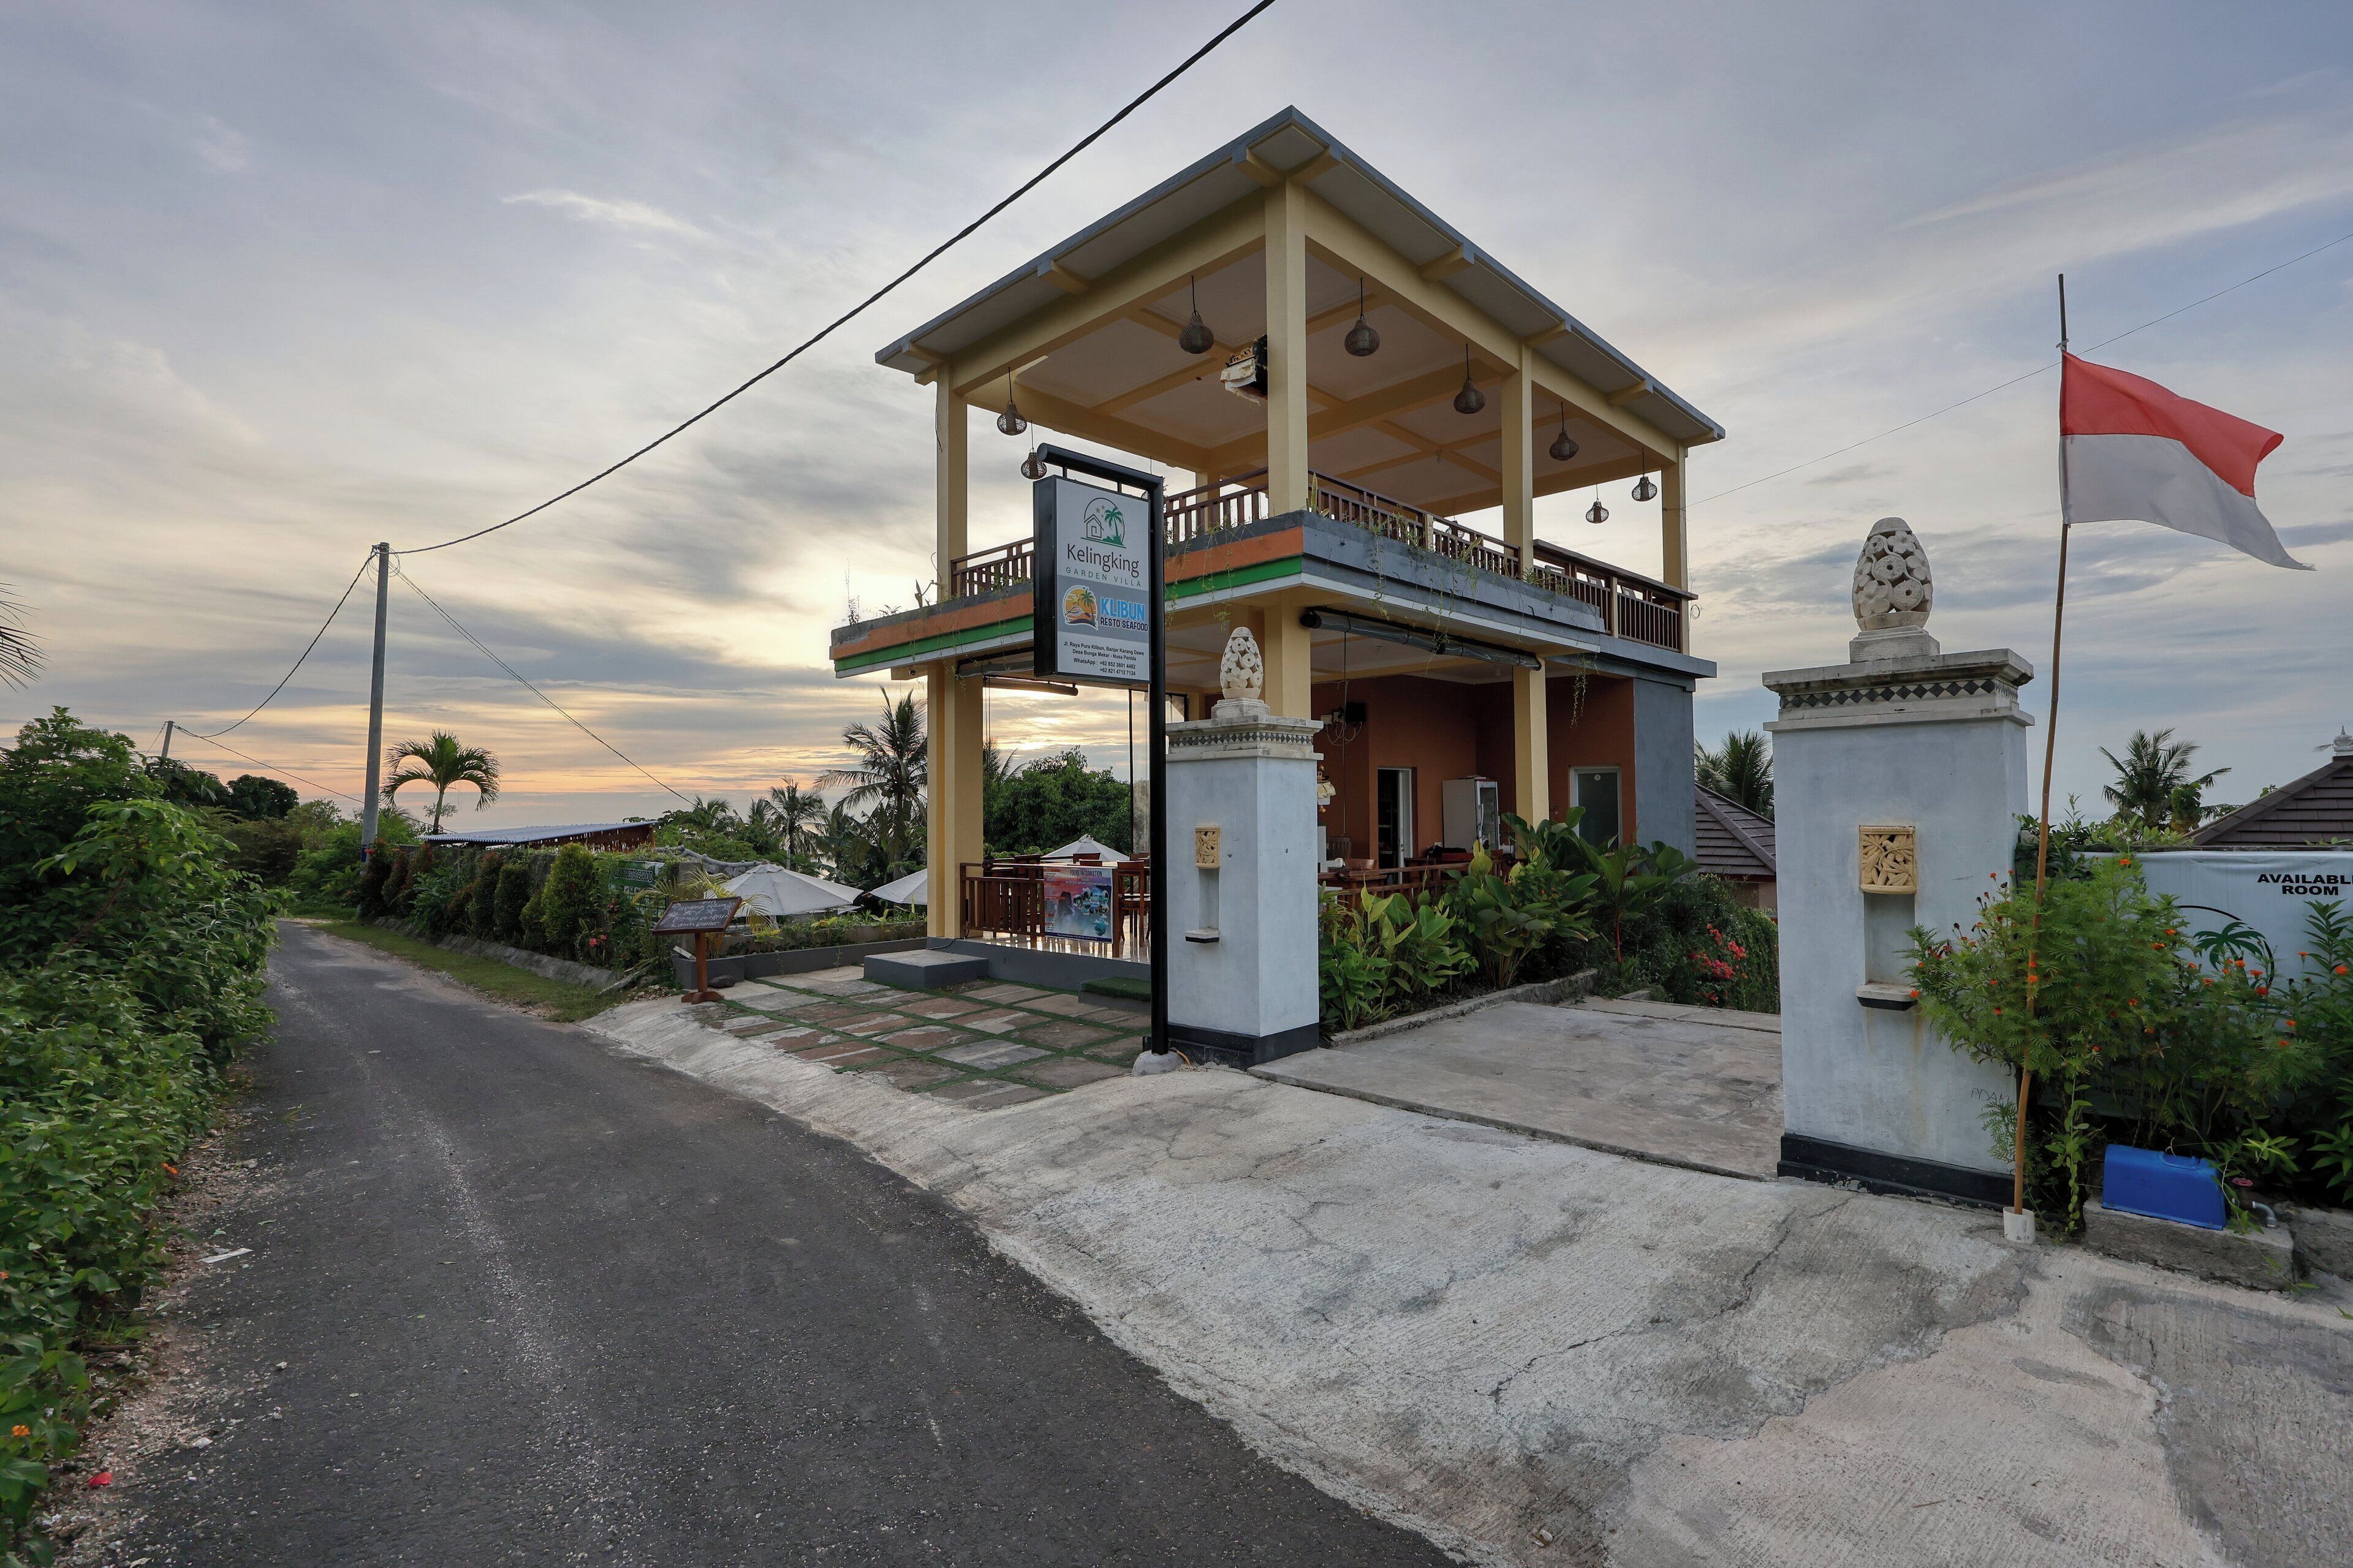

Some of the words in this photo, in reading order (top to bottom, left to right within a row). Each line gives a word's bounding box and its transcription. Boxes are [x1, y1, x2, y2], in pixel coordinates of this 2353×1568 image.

[1067, 543, 1139, 578] Kelingking
[1066, 567, 1107, 581] GARDEN
[1113, 575, 1141, 588] VILLA
[1101, 597, 1145, 621] KLIBUN
[1100, 616, 1120, 627] RESTO
[1122, 619, 1148, 632] SEAFOOD
[2257, 874, 2353, 884] AVAILABL
[2282, 885, 2338, 895] ROOM
[1971, 1088, 2010, 1104] PDAM
